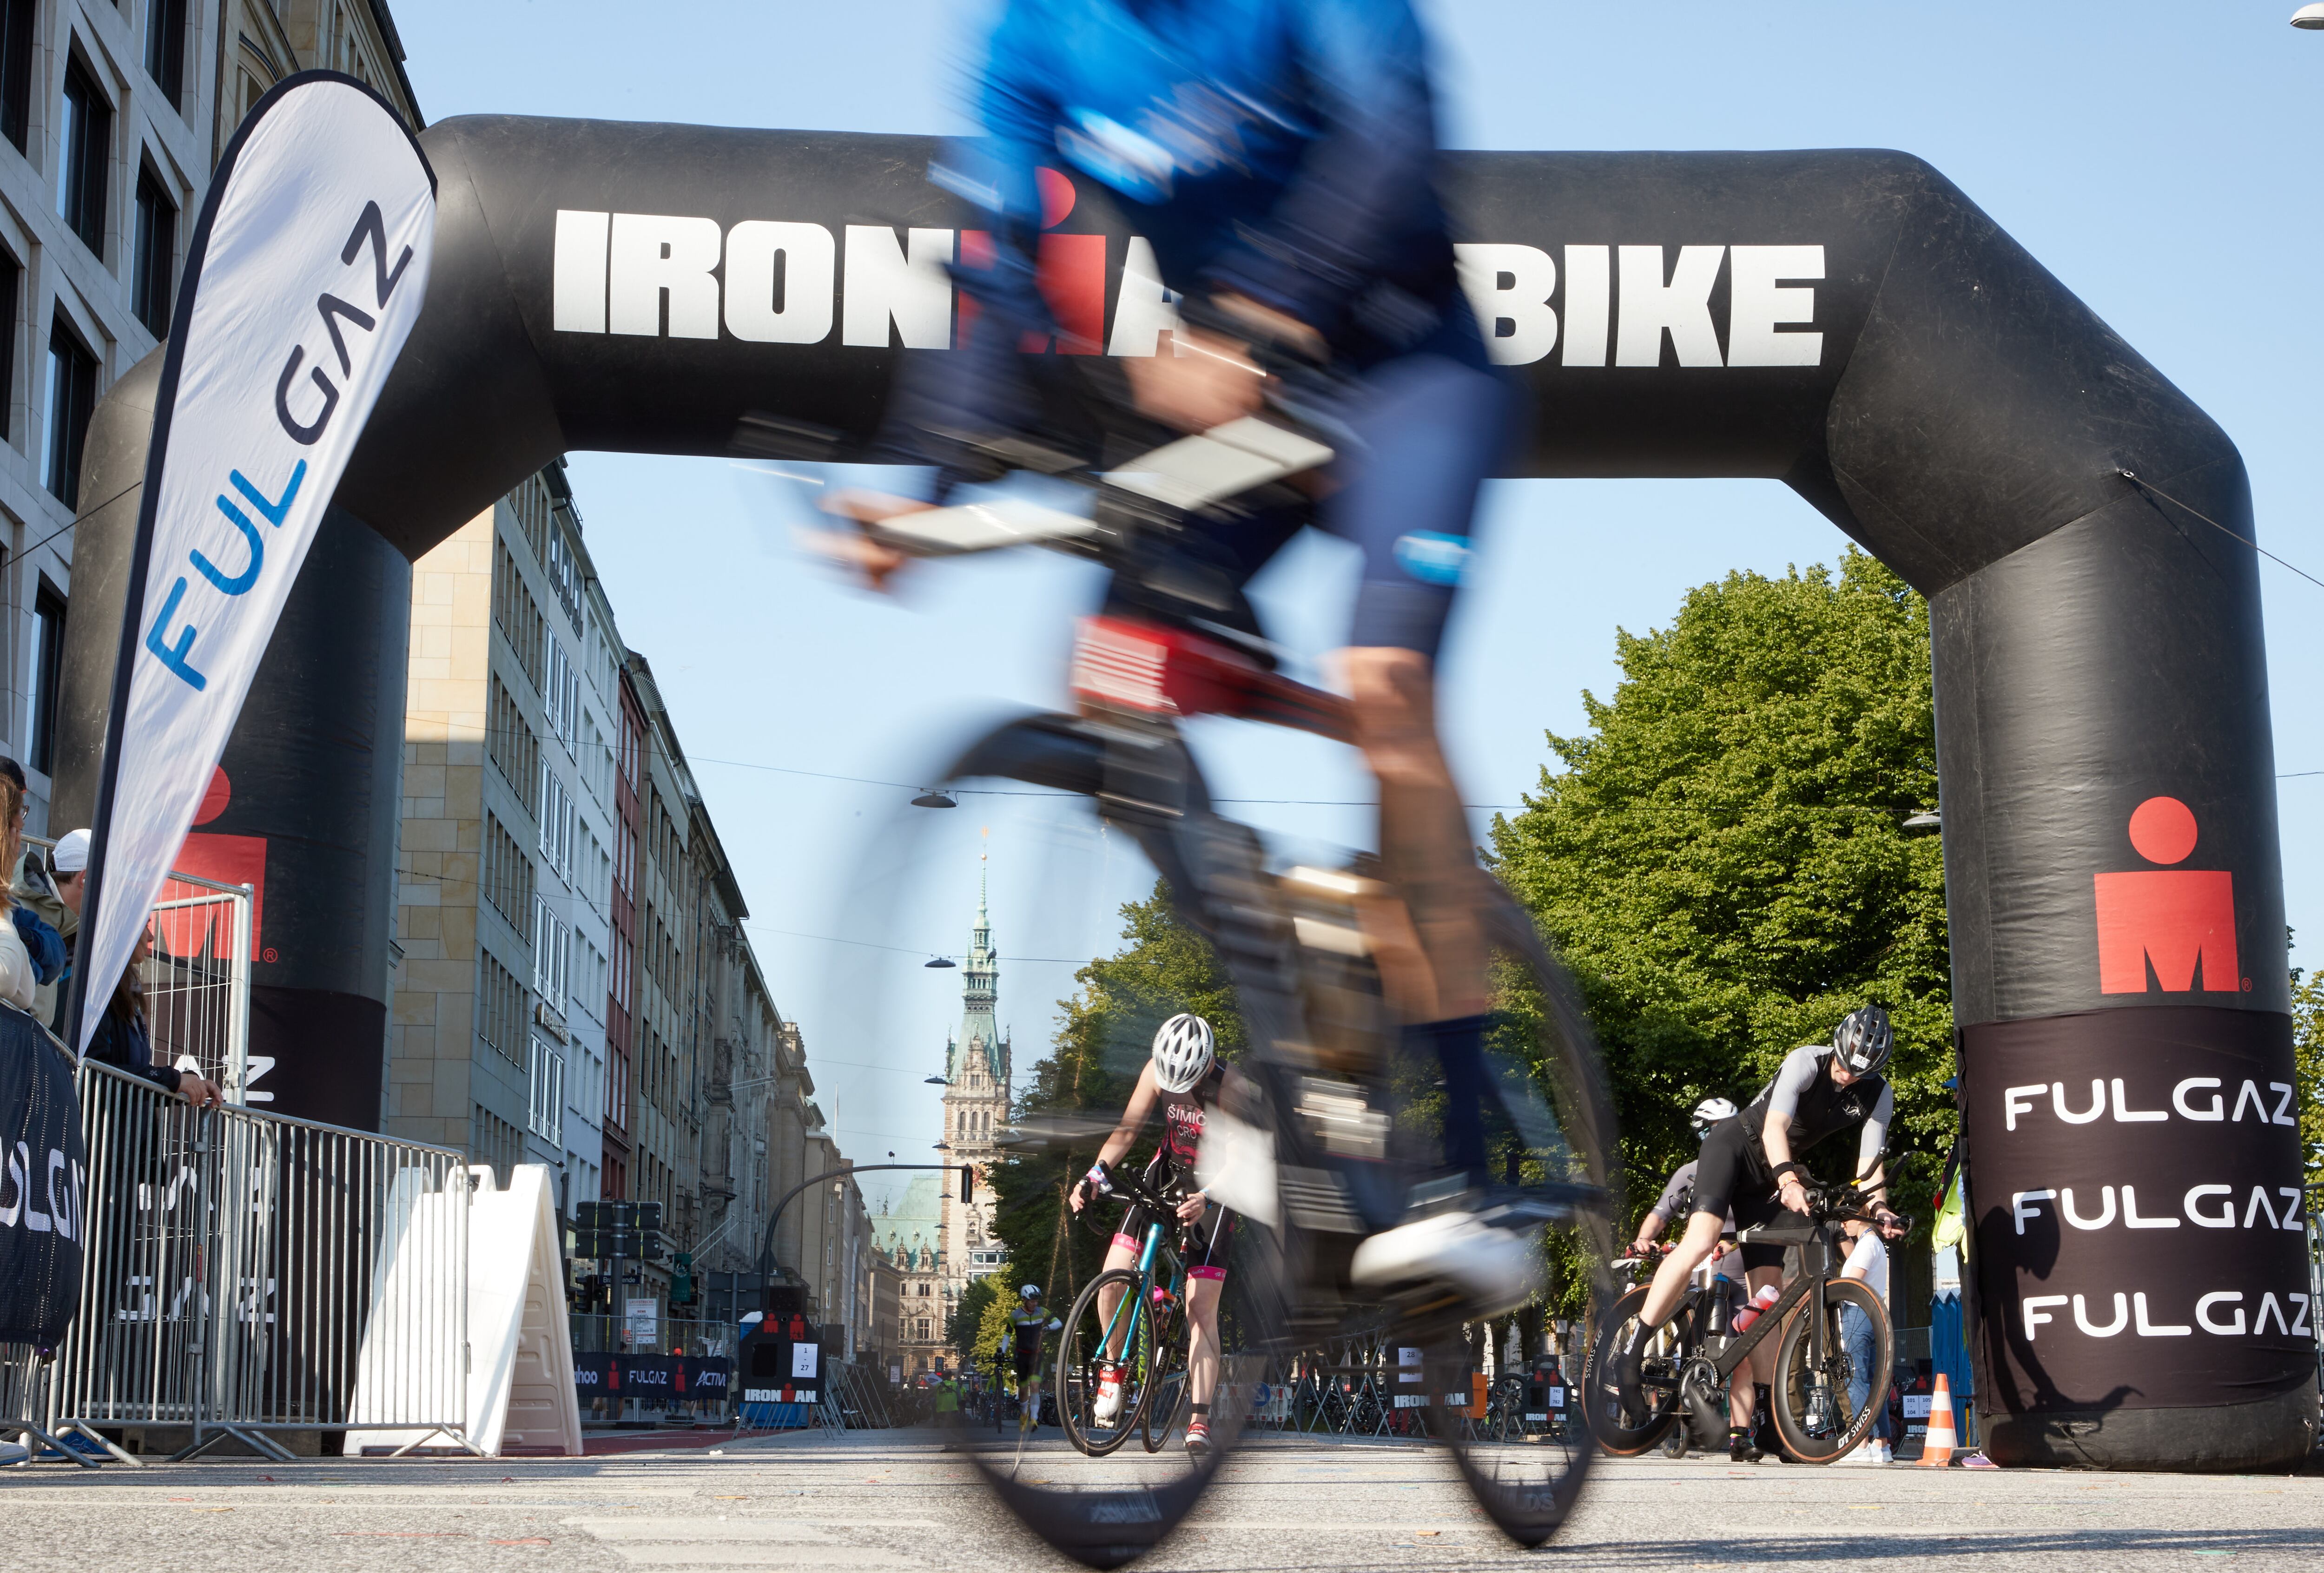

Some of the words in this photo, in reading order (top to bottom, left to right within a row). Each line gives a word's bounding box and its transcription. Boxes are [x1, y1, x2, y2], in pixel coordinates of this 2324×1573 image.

[1453, 243, 1826, 367] BIKE
[146, 200, 413, 691] FULGAZ
[1167, 1103, 1207, 1126] ŠIMIĆ
[2005, 1077, 2295, 1131] FULGAZ
[1176, 1125, 1197, 1139] CRO
[2012, 1184, 2304, 1235] FULGAZ
[2023, 1290, 2311, 1342] FULGAZ
[629, 1370, 667, 1384] FULGAZ
[1585, 1347, 1596, 1379] SWISS
[1838, 1432, 1849, 1449] DT
[1851, 1406, 1871, 1437] SWISS
